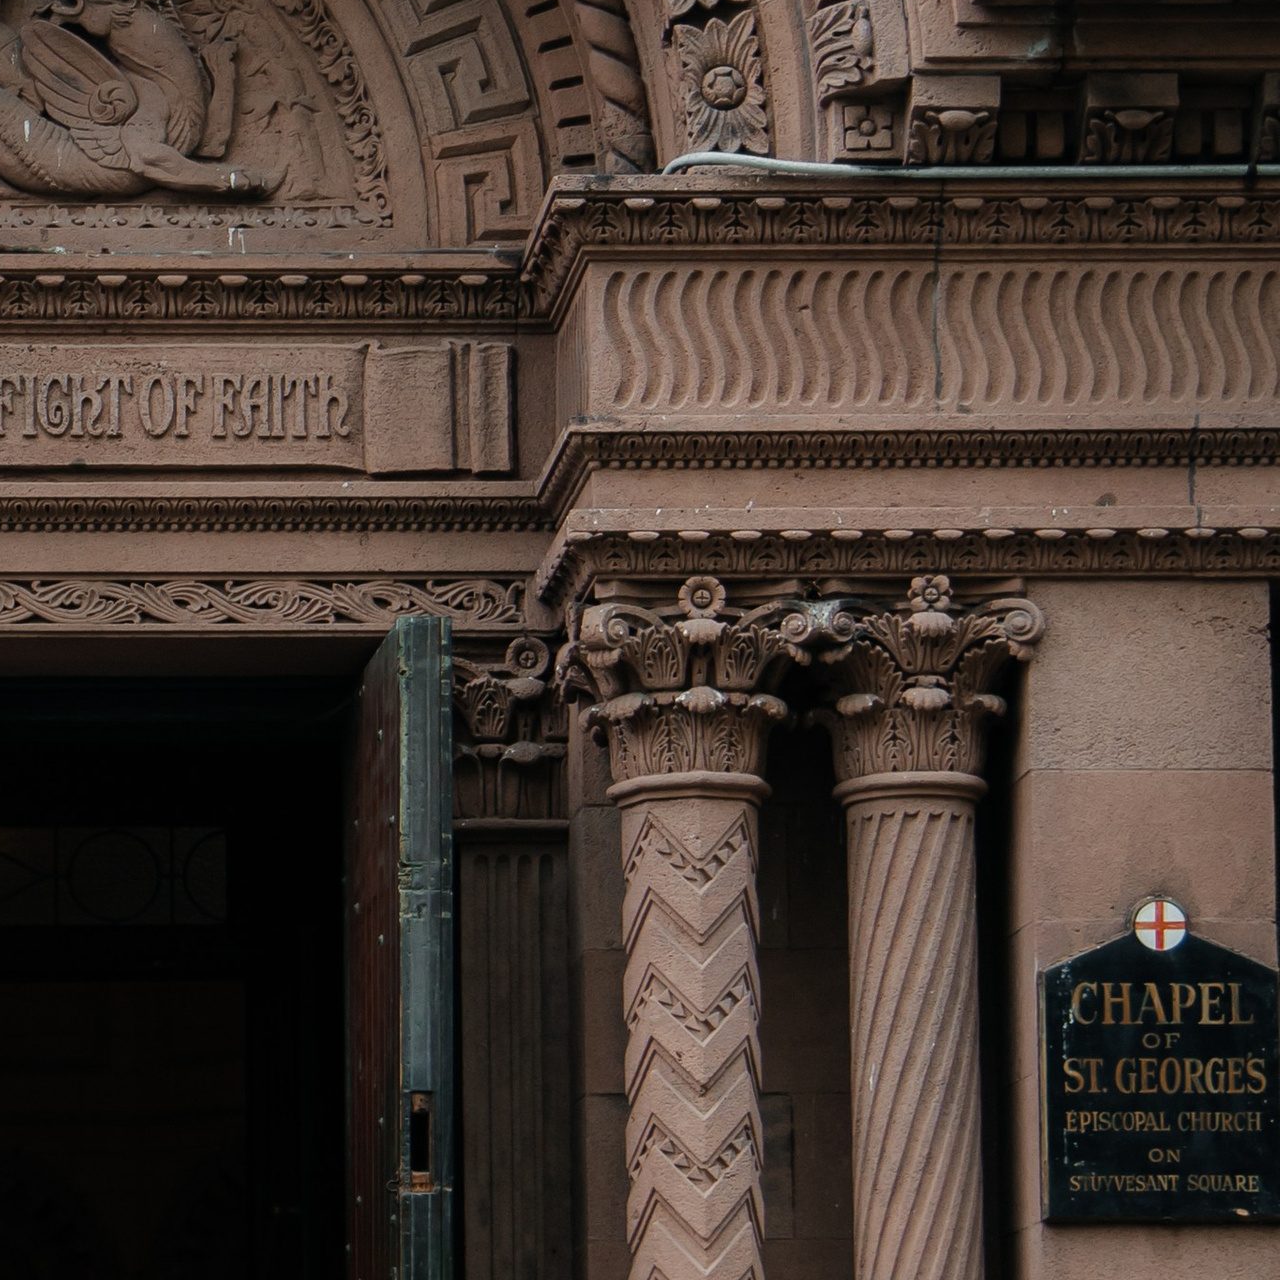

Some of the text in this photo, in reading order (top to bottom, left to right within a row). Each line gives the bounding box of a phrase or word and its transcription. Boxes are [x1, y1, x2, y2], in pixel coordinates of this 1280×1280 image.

[140, 373, 205, 438] OF
[212, 373, 351, 438] FAITH
[1070, 981, 1255, 1025] CHAPEL
[1142, 1032, 1181, 1049] OF
[1063, 1052, 1267, 1095] ST. GEORGE'S
[1065, 1111, 1263, 1133] EPISCOPAL CHURCH
[1148, 1148, 1181, 1163] ON
[1069, 1174, 1259, 1193] STUYVESANT SQUARE
